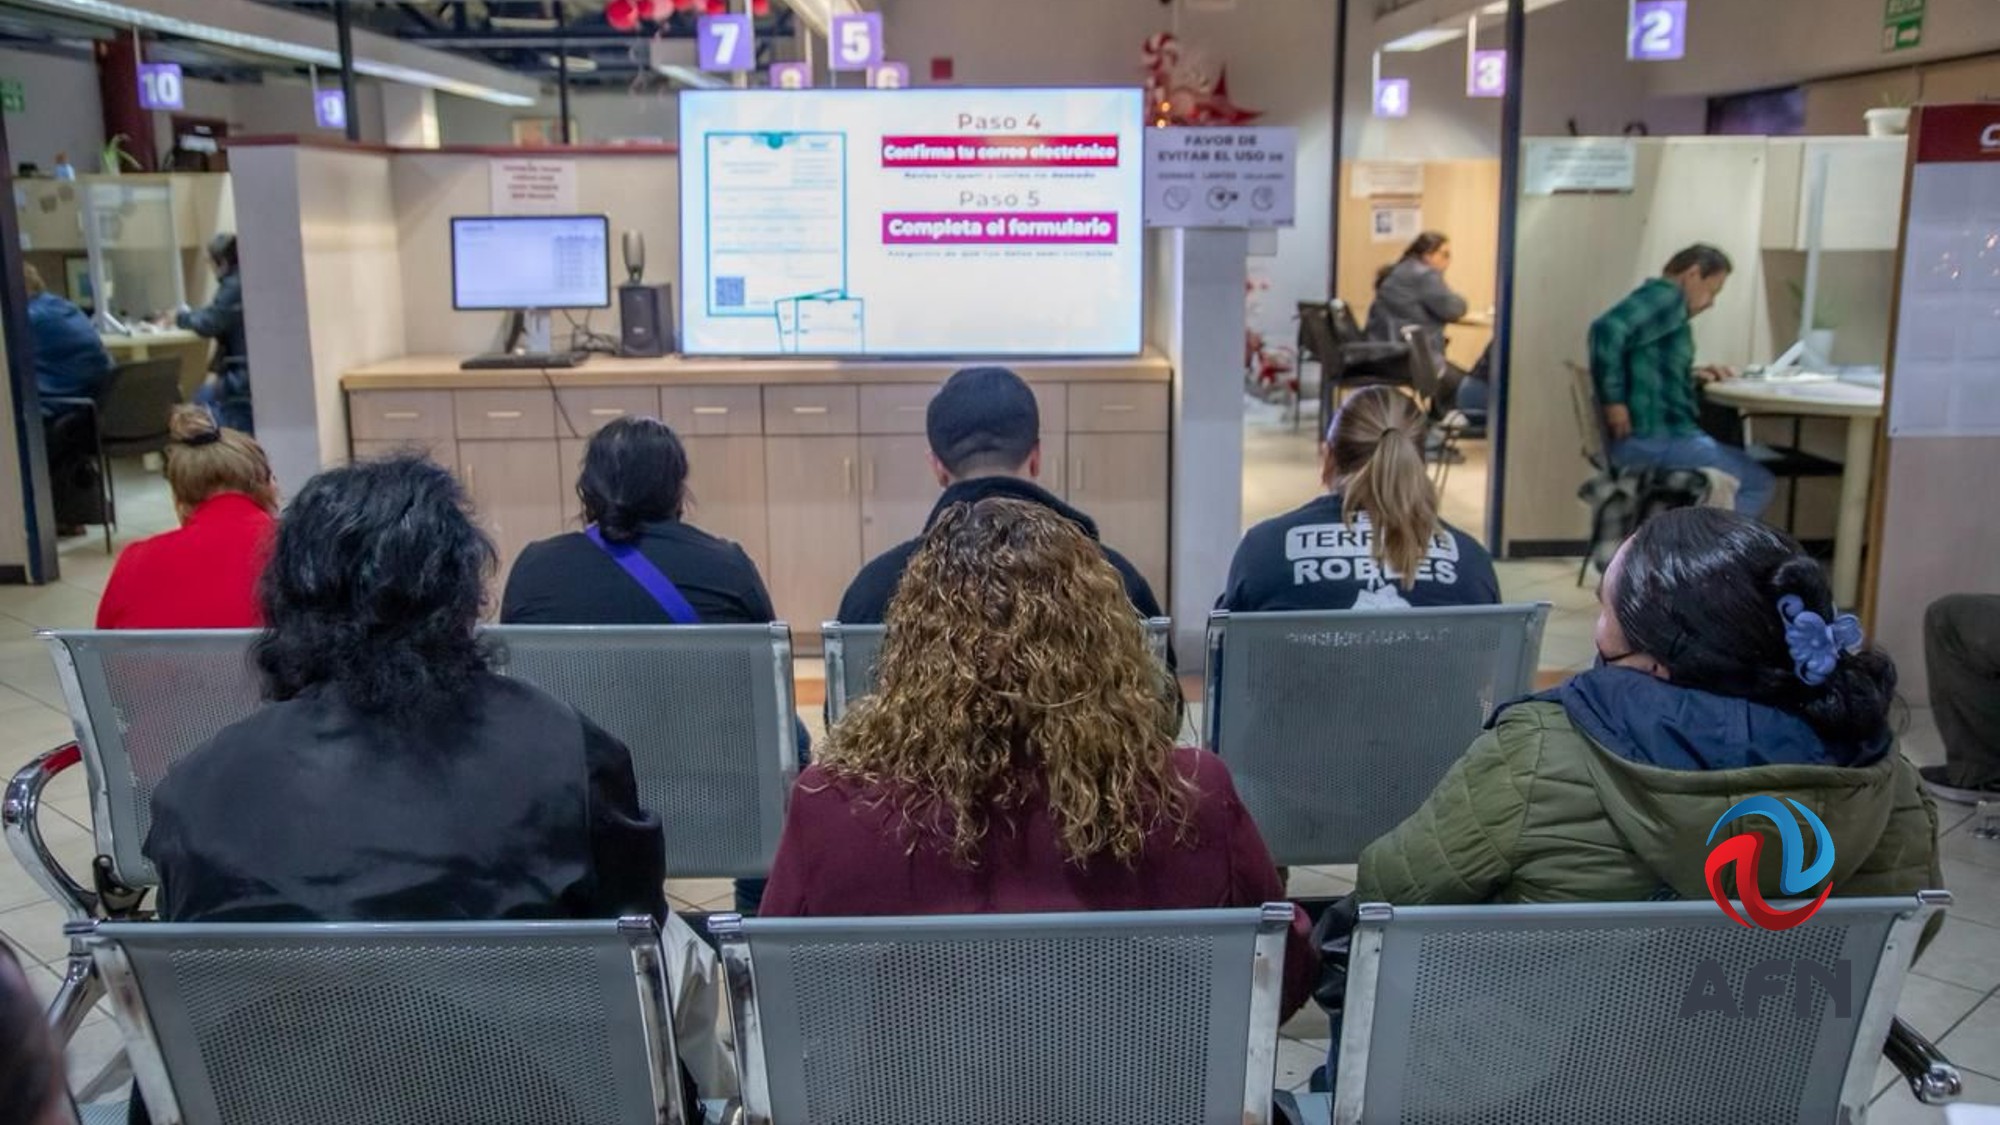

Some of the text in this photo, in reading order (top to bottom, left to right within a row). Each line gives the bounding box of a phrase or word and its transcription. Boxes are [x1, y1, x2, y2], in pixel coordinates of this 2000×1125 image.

[711, 23, 740, 65] 7
[841, 21, 871, 63] 5
[1642, 10, 1673, 50] 2
[1476, 56, 1503, 90] 3
[142, 72, 178, 104] 10
[1380, 83, 1402, 113] 4
[322, 96, 342, 124] 9
[957, 113, 1041, 130] Paso 4
[884, 143, 955, 161] Confirma
[957, 145, 976, 161] tu
[977, 146, 1028, 161] correo
[1184, 135, 1258, 146] FAVOR DE
[1158, 150, 1210, 161] EVITAR
[1214, 150, 1231, 161] EL
[1235, 150, 1266, 161] USO
[959, 189, 1041, 207] Paso 5
[887, 217, 1113, 240] Completa el formulario
